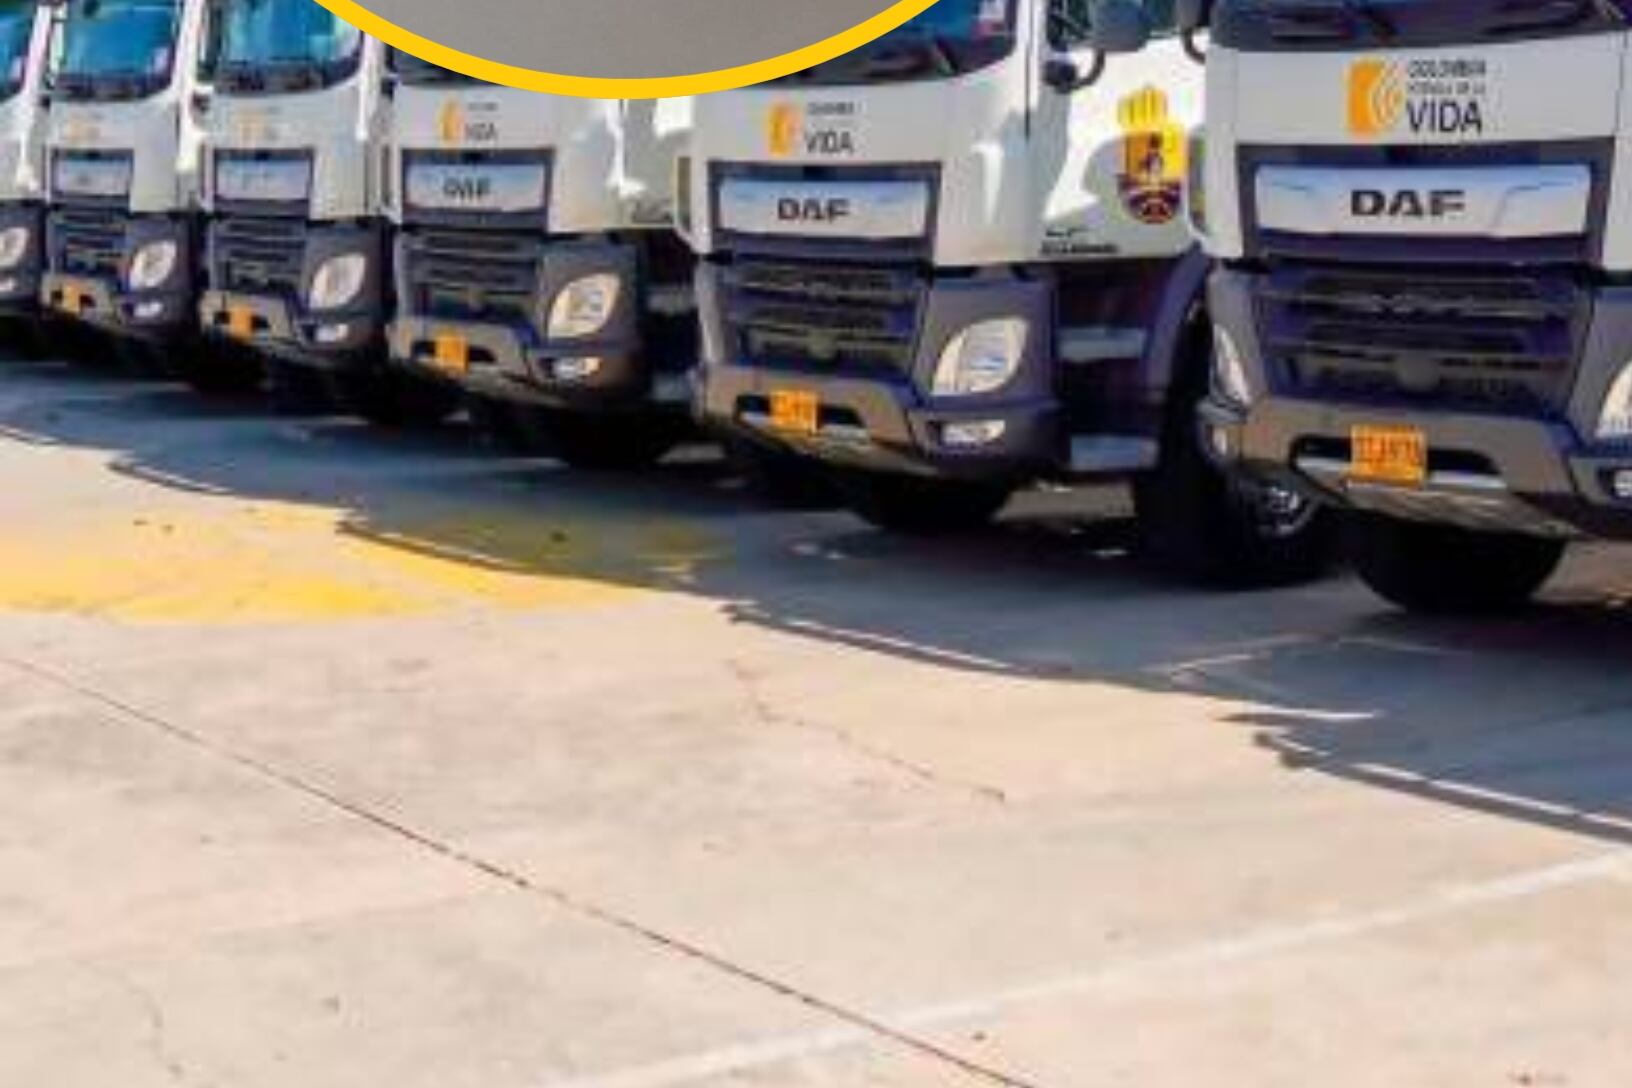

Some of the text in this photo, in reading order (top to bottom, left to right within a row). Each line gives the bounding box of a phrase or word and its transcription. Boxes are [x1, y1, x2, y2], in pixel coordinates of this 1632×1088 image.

[1406, 98, 1483, 134] VIDA
[777, 197, 851, 222] DAF
[1351, 188, 1466, 217] DAF
